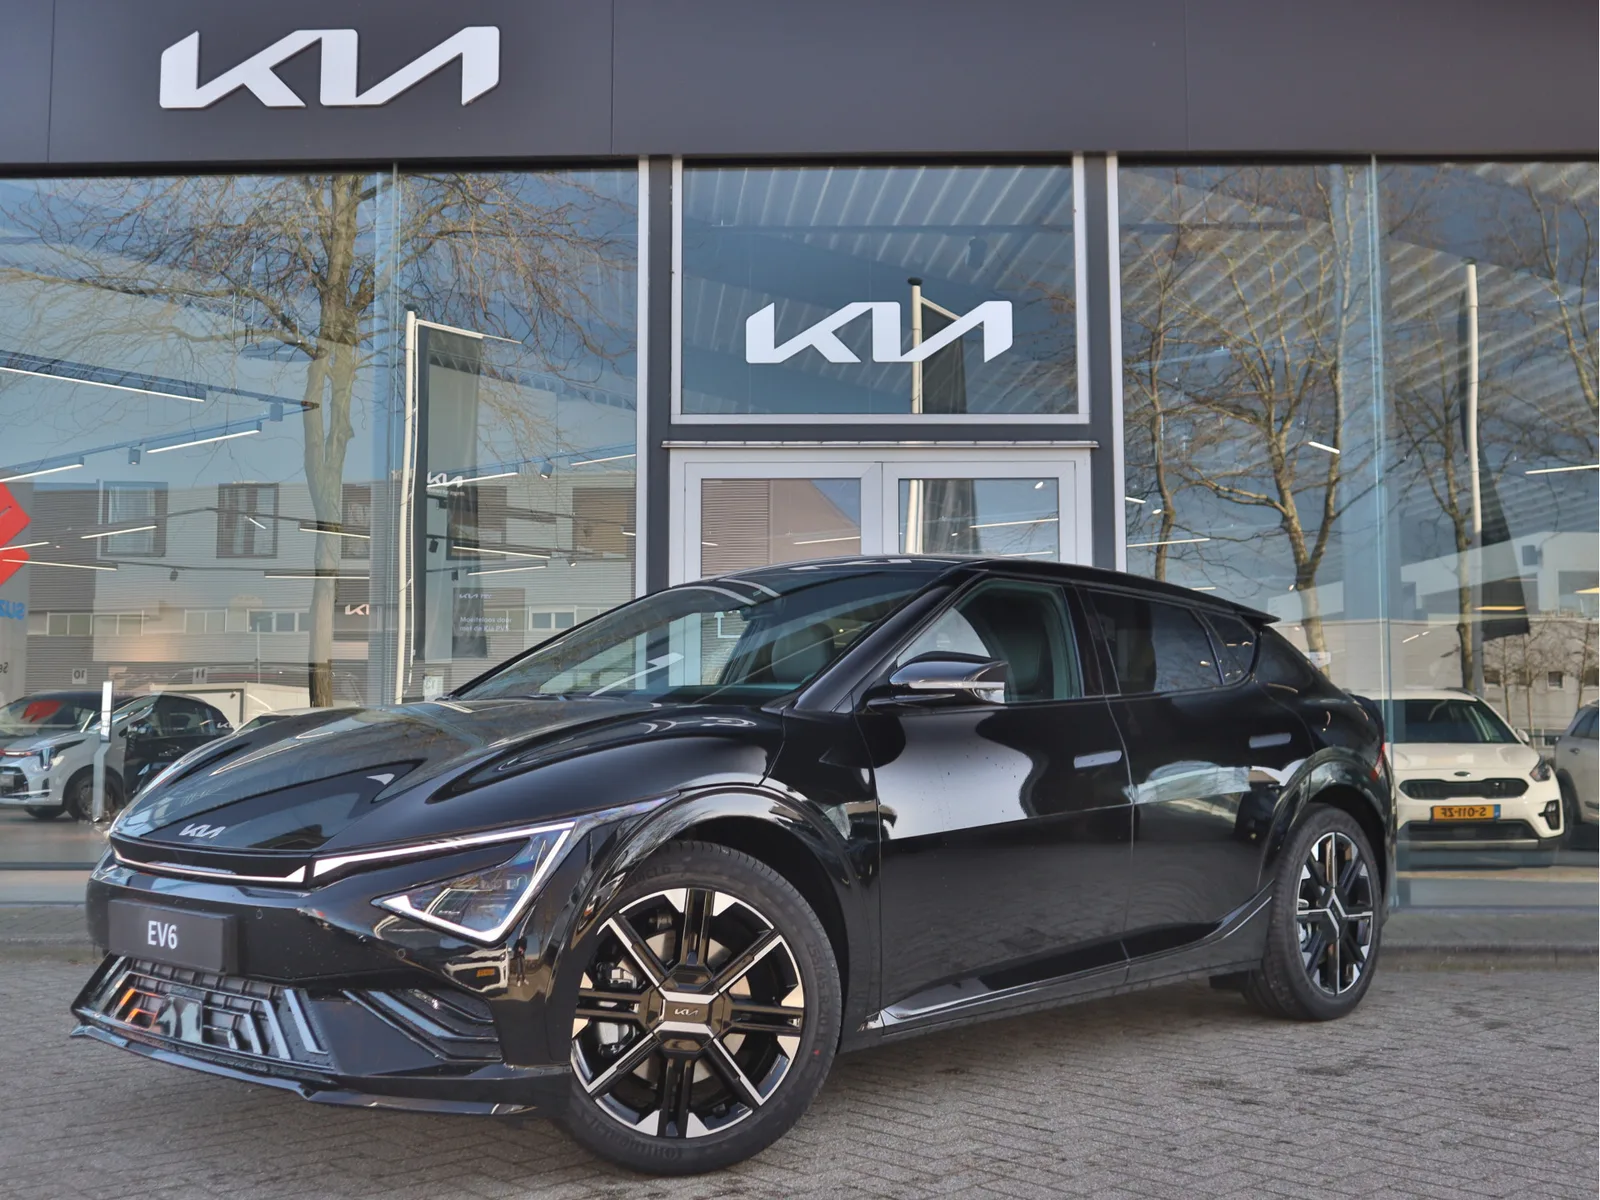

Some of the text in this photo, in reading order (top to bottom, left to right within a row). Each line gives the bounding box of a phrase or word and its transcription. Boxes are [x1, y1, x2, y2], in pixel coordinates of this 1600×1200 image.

[159, 26, 500, 109] KIA
[745, 300, 1013, 364] KIA
[426, 471, 463, 488] KIA
[179, 823, 226, 839] KIA
[147, 920, 178, 950] EV6
[674, 1008, 699, 1017] KIA
